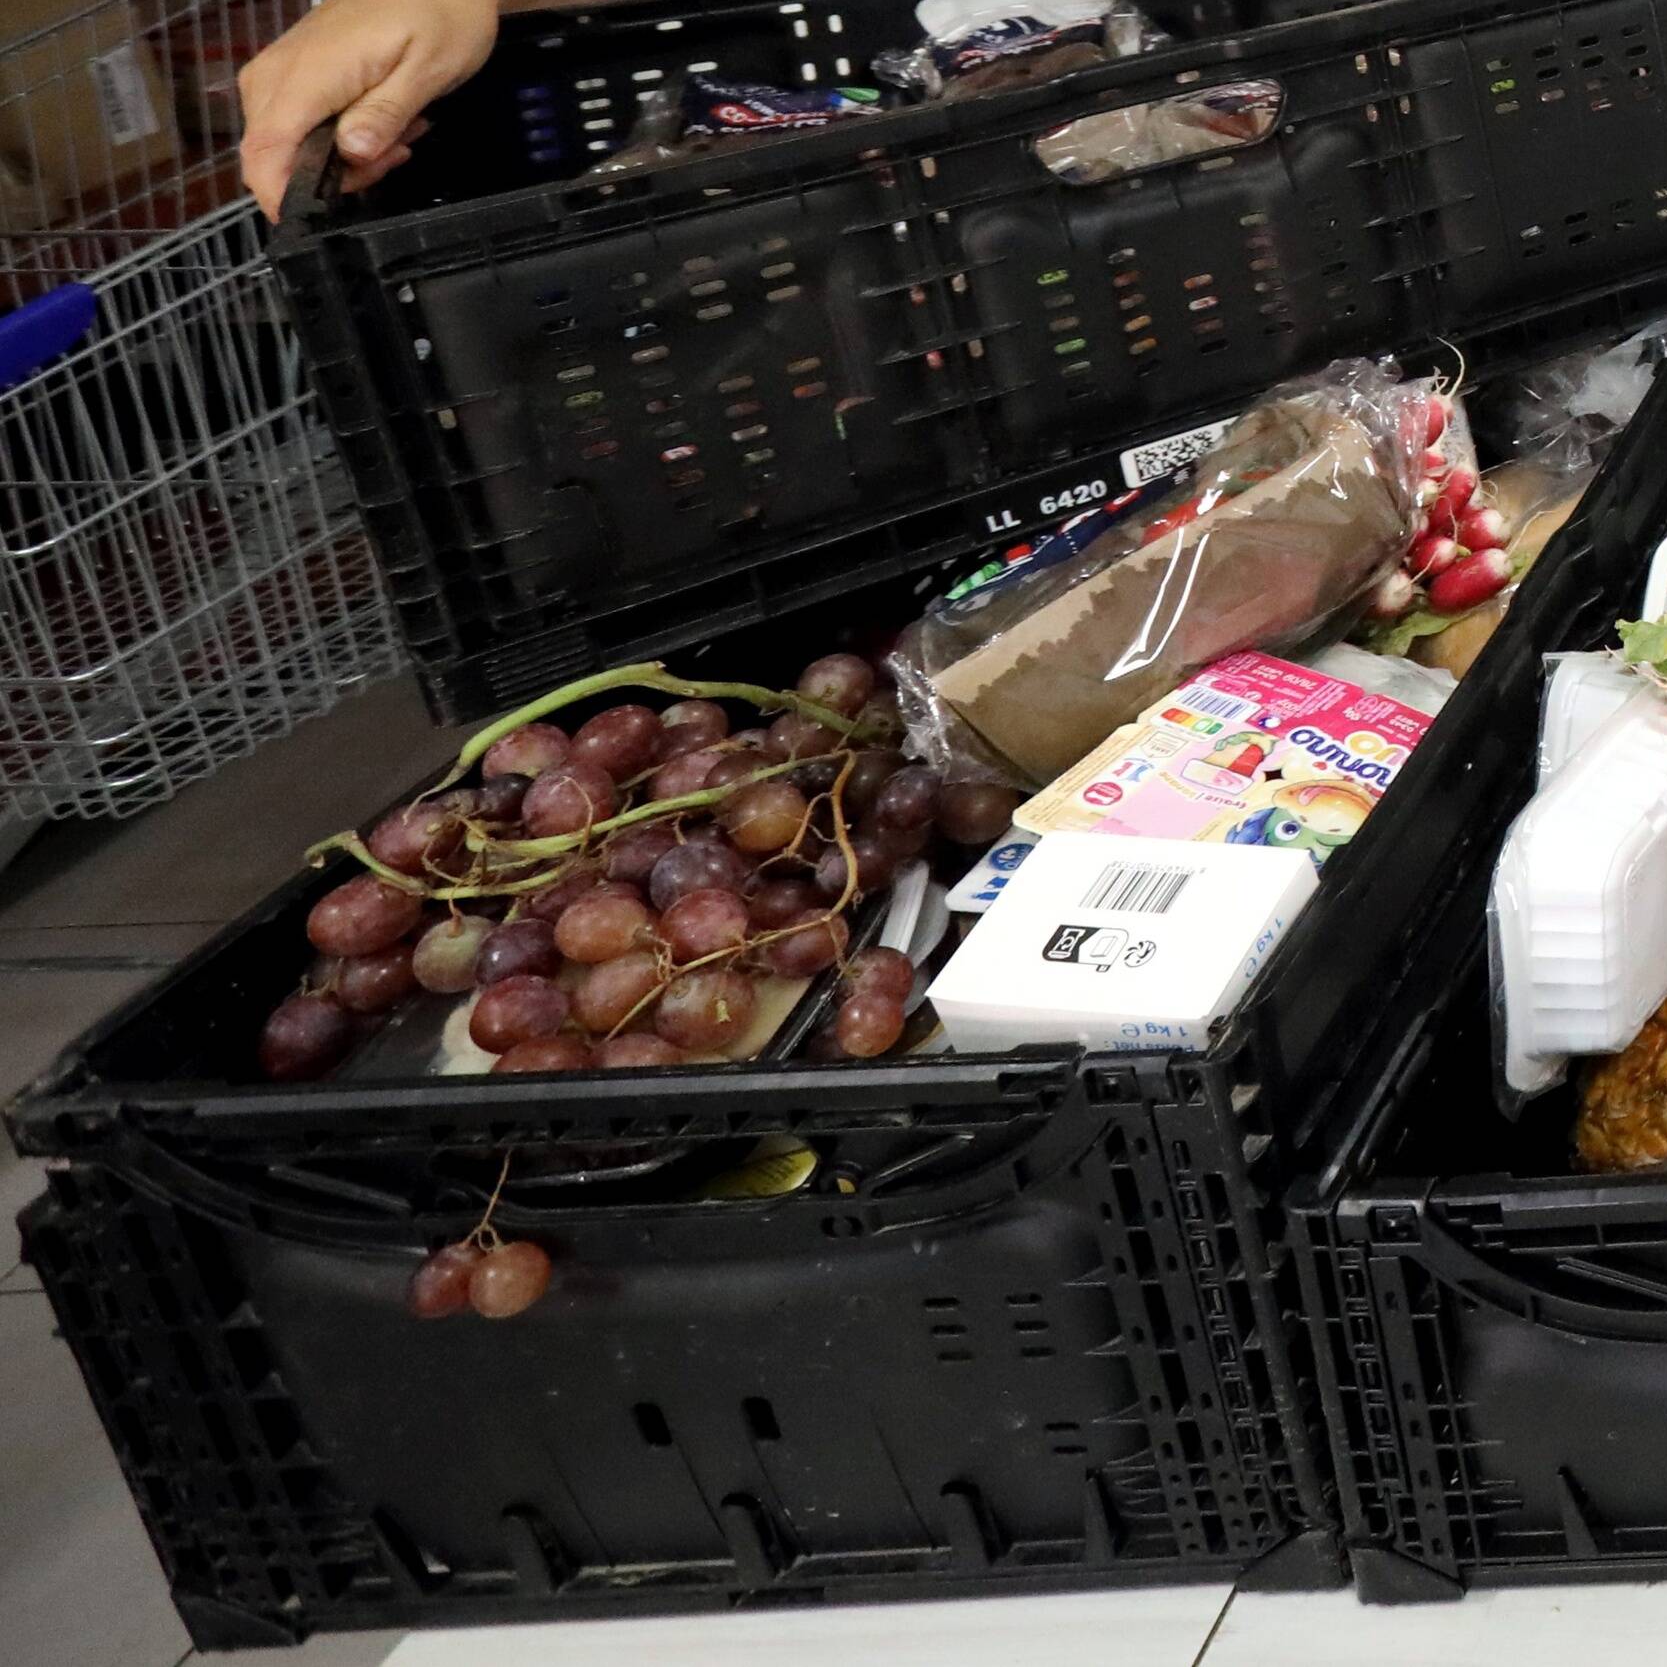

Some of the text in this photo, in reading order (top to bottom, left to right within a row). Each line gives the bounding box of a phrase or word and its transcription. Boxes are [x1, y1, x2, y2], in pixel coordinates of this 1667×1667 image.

[986, 480, 1107, 533] LL 6420
[1289, 728, 1393, 788] nonino
[1144, 1021, 1172, 1039] kg
